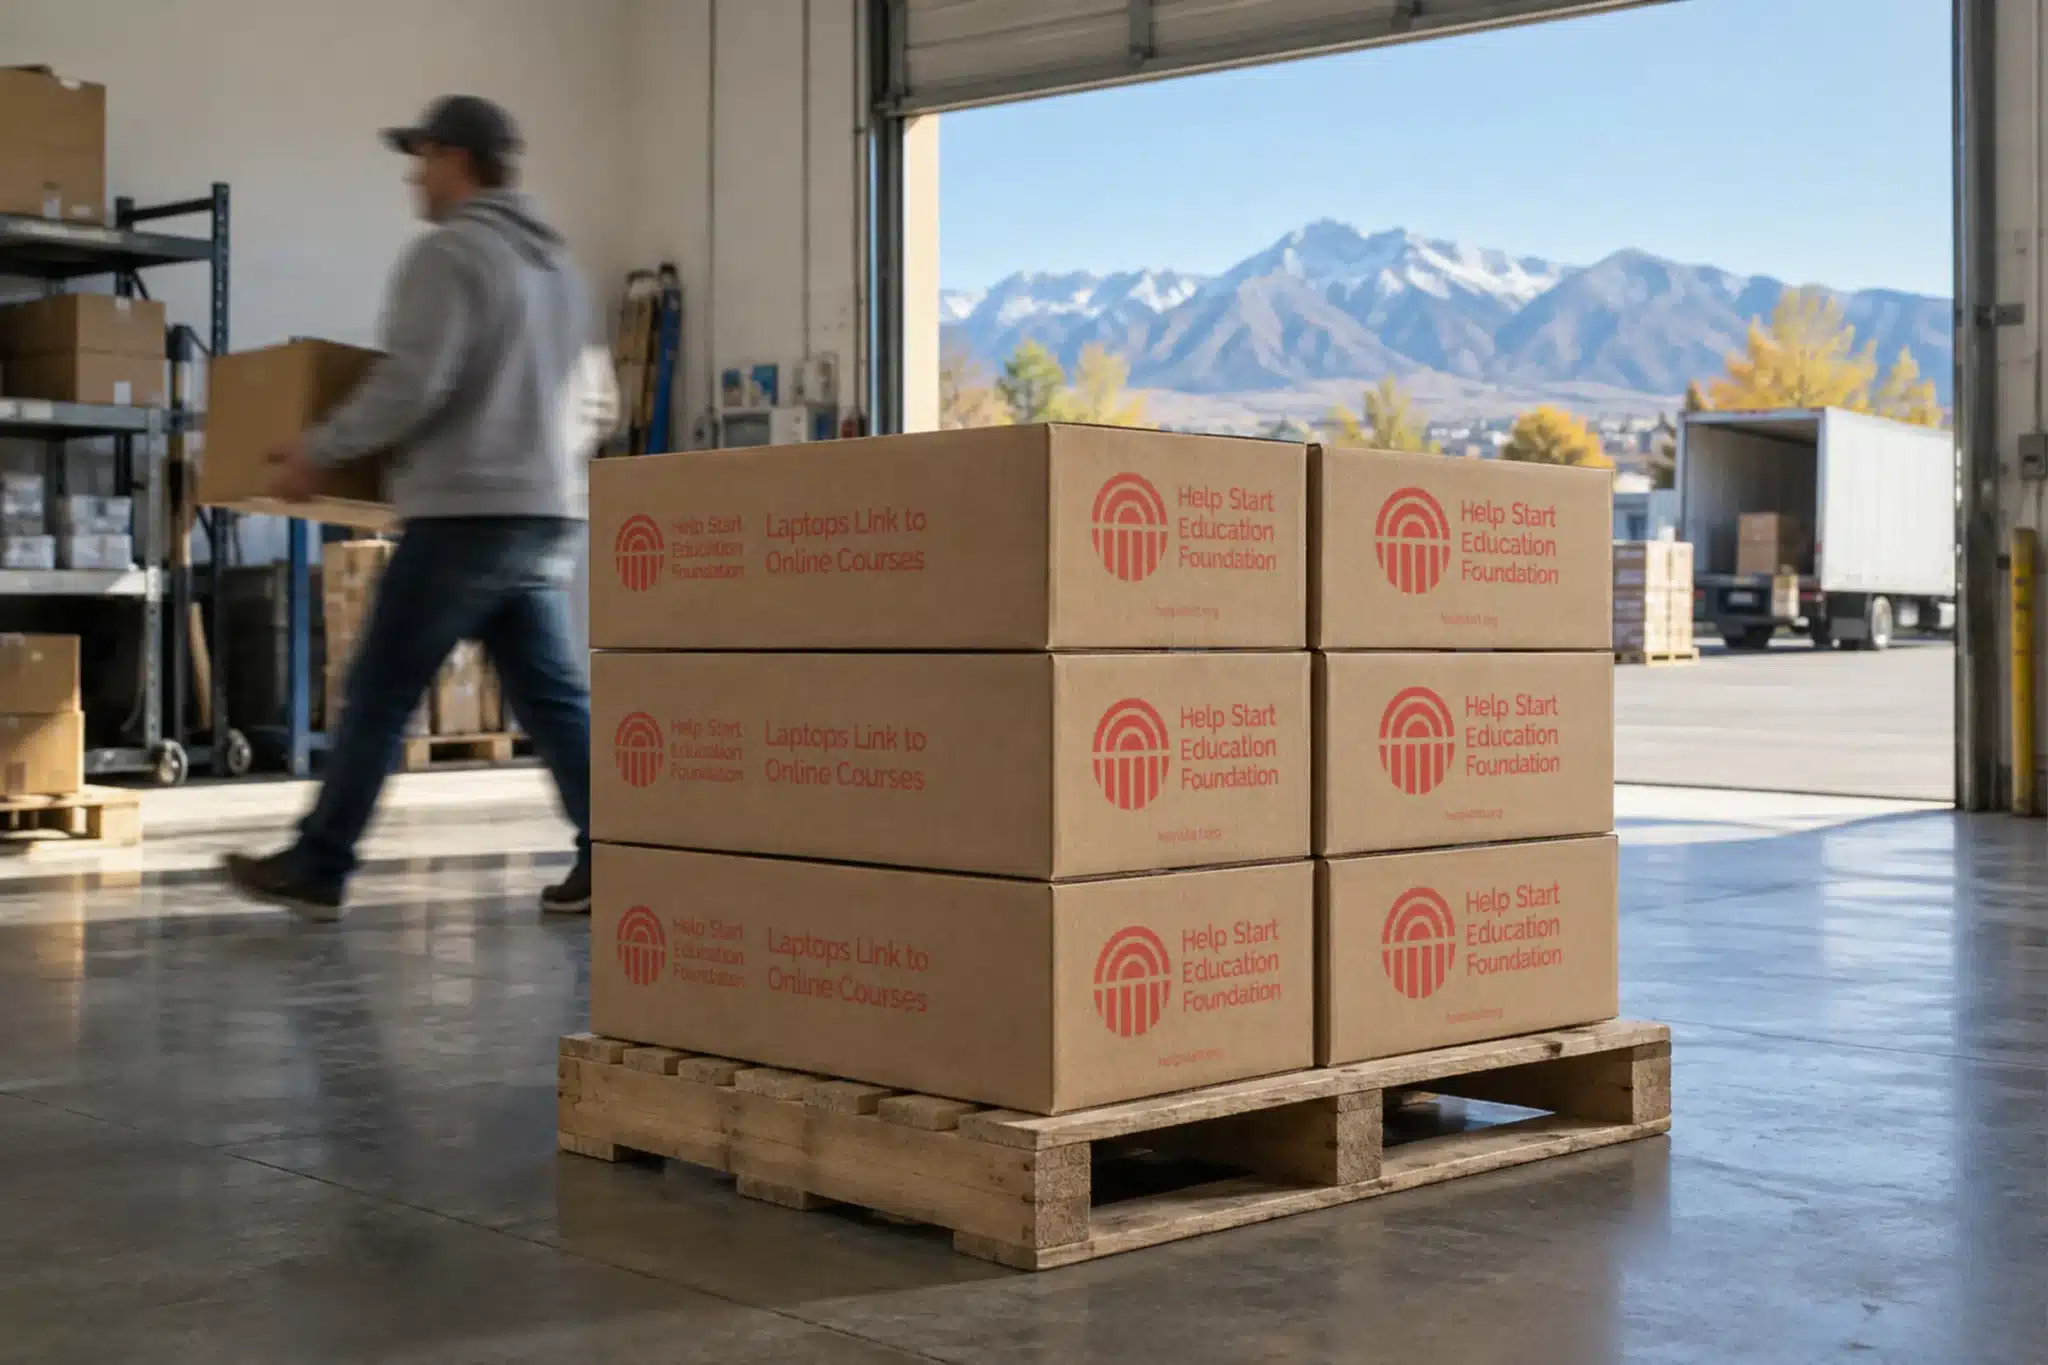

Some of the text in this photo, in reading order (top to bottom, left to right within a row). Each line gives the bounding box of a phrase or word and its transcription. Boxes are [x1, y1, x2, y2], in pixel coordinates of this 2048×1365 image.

[1178, 485, 1275, 515] Help Start
[1461, 499, 1556, 530] Help Start
[766, 506, 926, 544] Laptops Link to
[1178, 515, 1275, 543] Education
[1179, 545, 1277, 571] Foundation
[1461, 531, 1557, 556] Education
[765, 548, 925, 574] Online Courses
[1462, 560, 1559, 585] Foundation
[1181, 703, 1276, 734] Help Start
[1466, 693, 1558, 722] Help Start
[765, 719, 927, 752] Laptops Link to
[1181, 732, 1277, 760] Education
[1466, 723, 1559, 748] Education
[765, 757, 925, 790] Online Courses
[1182, 764, 1279, 791] Foundation
[1466, 752, 1560, 777] Foundation
[1466, 880, 1560, 917] Help Start
[1182, 919, 1279, 953] Help Start
[1466, 913, 1560, 946] Education
[768, 927, 929, 972] Laptops Link to
[1467, 945, 1562, 976] Foundation
[1182, 950, 1279, 983] Education
[768, 965, 927, 1012] Online Courses
[1183, 981, 1281, 1012] Foundation
